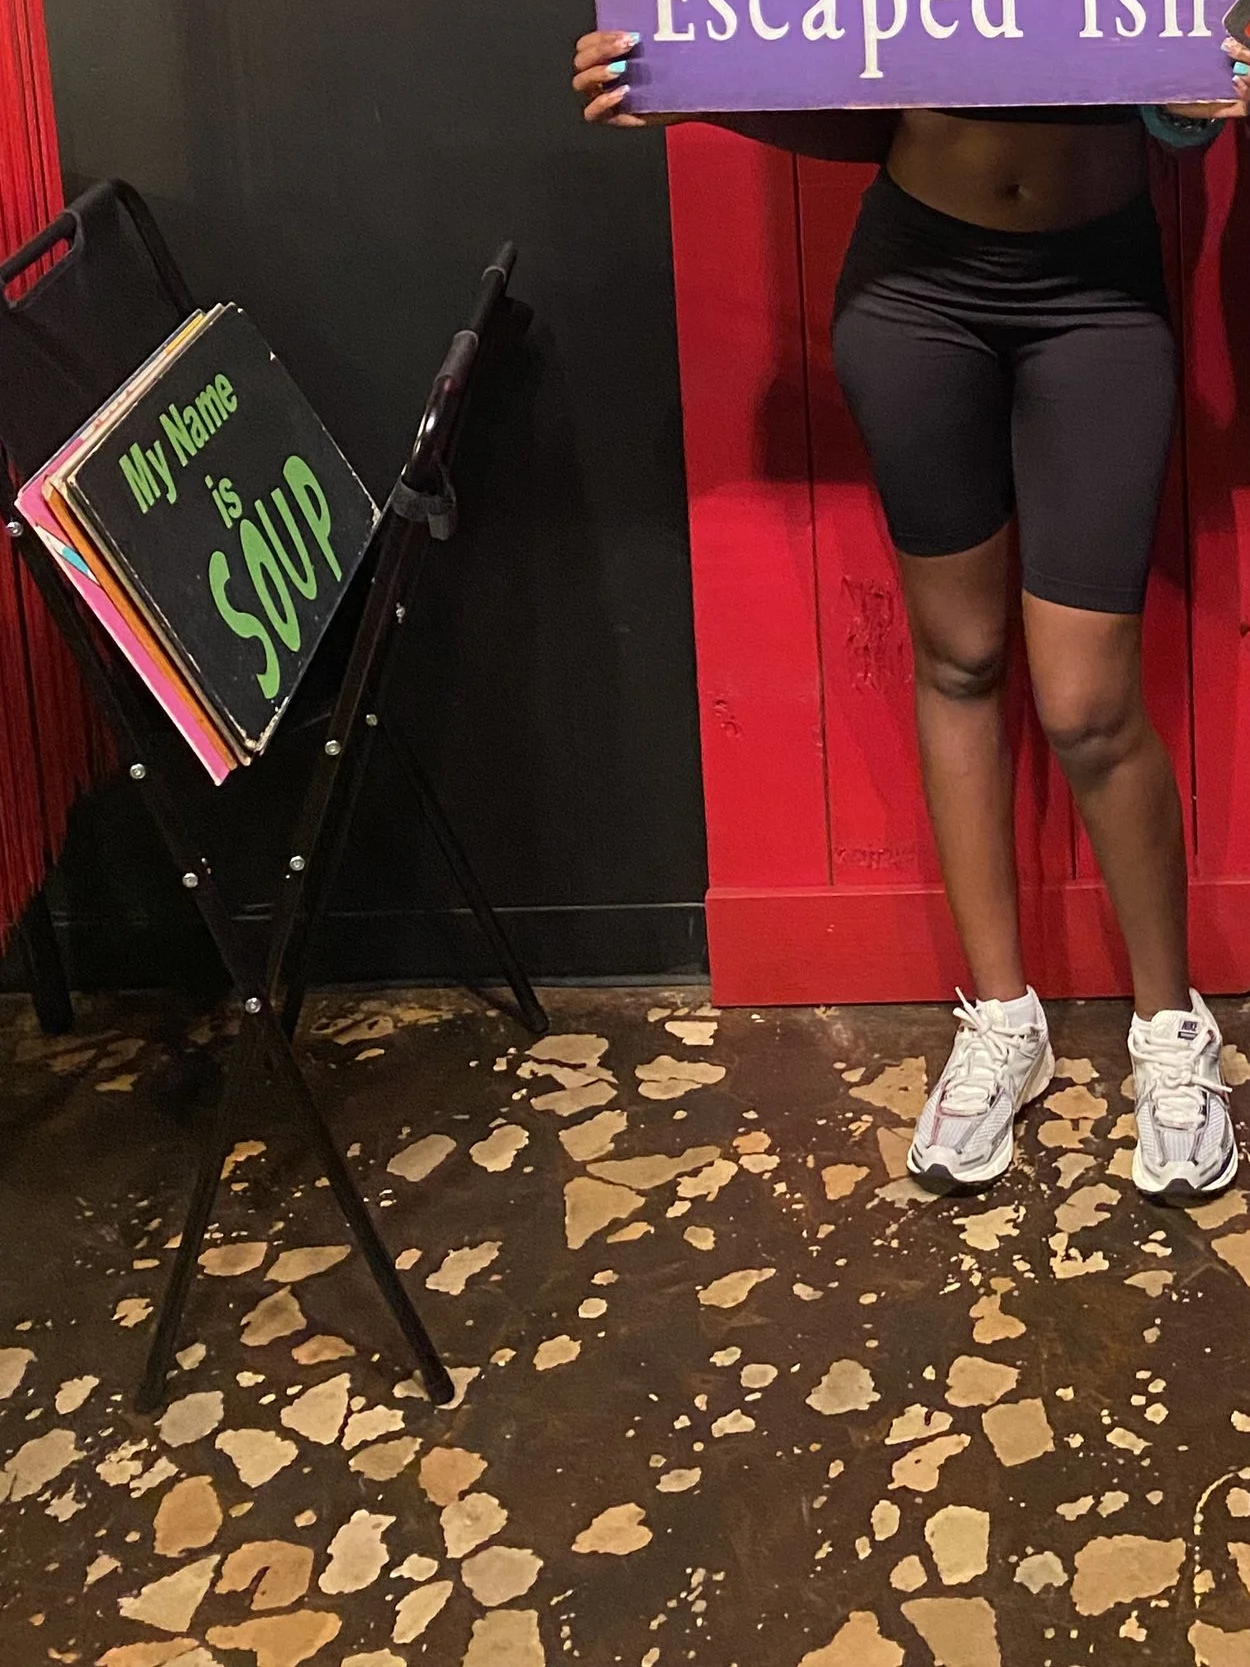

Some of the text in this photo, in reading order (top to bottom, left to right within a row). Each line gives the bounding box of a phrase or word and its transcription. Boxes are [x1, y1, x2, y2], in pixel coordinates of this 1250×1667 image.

[118, 373, 238, 514] My Name
[204, 474, 243, 529] is
[208, 455, 342, 700] SOUP
